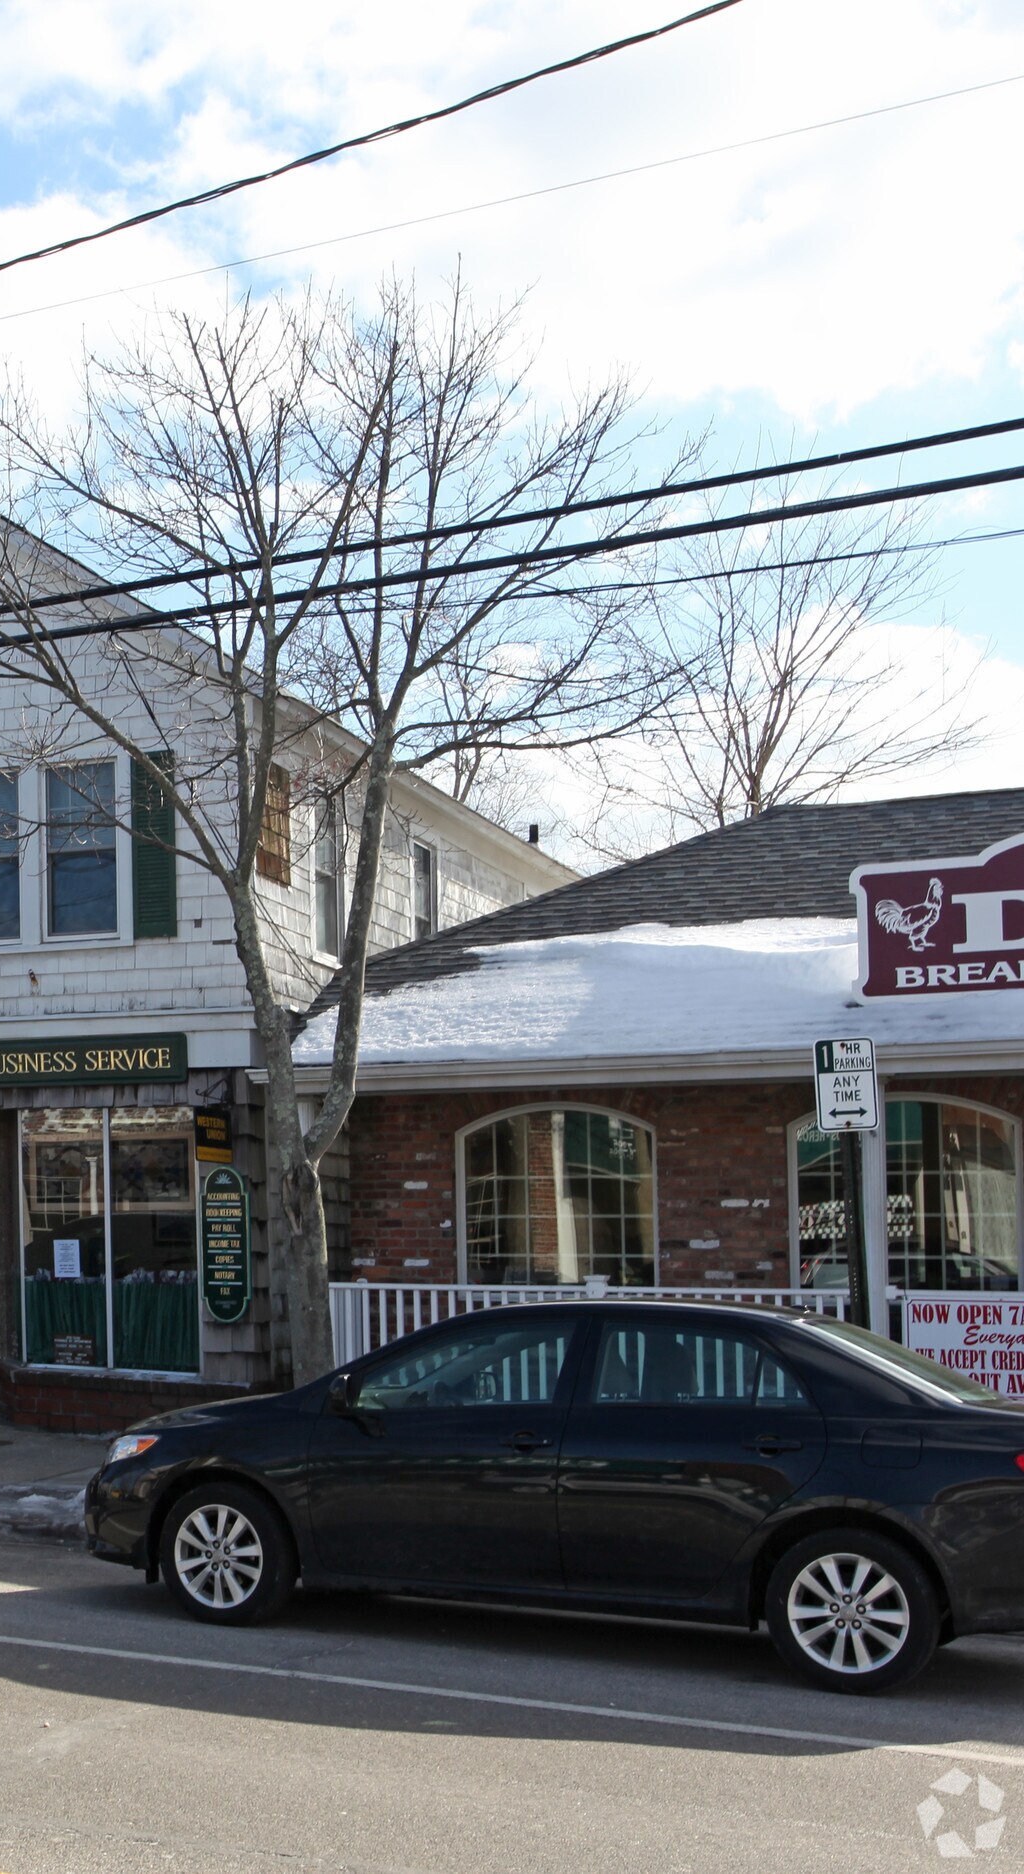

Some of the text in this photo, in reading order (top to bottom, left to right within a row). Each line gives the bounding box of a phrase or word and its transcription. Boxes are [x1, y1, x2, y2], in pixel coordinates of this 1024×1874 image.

[895, 959, 1024, 989] BREA
[845, 1043, 861, 1054] HR
[84, 1047, 171, 1072] SERVICE
[822, 1045, 828, 1068] 1
[834, 1057, 871, 1070] PARKING
[833, 1075, 860, 1088] ANY
[833, 1090, 862, 1102] TIME
[196, 1115, 225, 1128] WESTERN
[207, 1129, 226, 1140] UNION
[207, 1192, 240, 1200] ACCOUNTING
[211, 1224, 236, 1232] PAY ROLL
[209, 1239, 240, 1248] INCOME TAX
[215, 1255, 234, 1264] COPIES
[214, 1271, 235, 1280] NOTARY
[220, 1287, 231, 1296] FAX
[912, 1304, 950, 1323] NOW
[957, 1305, 1002, 1325] OPEN
[939, 1349, 986, 1369] ACCEPT
